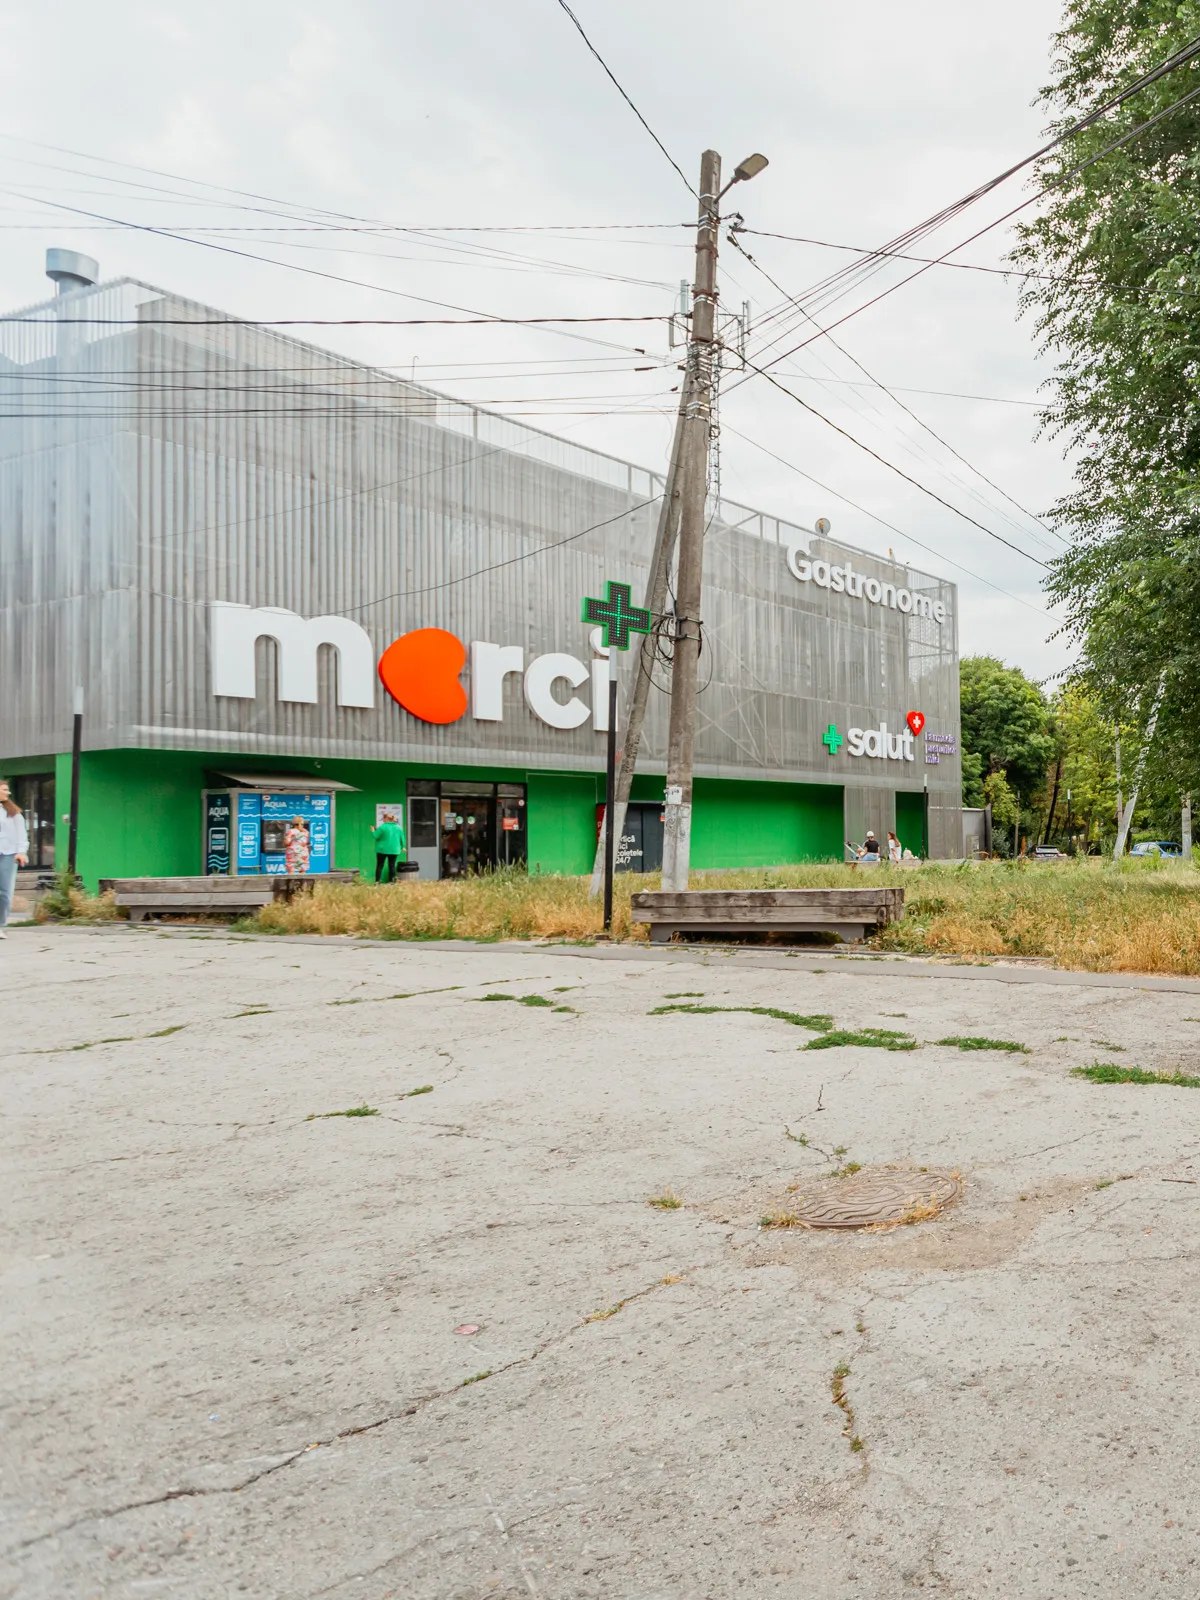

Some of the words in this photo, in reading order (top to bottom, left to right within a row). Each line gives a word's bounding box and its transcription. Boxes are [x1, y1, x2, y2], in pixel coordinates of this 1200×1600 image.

[787, 545, 947, 624] Gastronome
[847, 722, 914, 762] salut
[209, 807, 229, 817] AQUA
